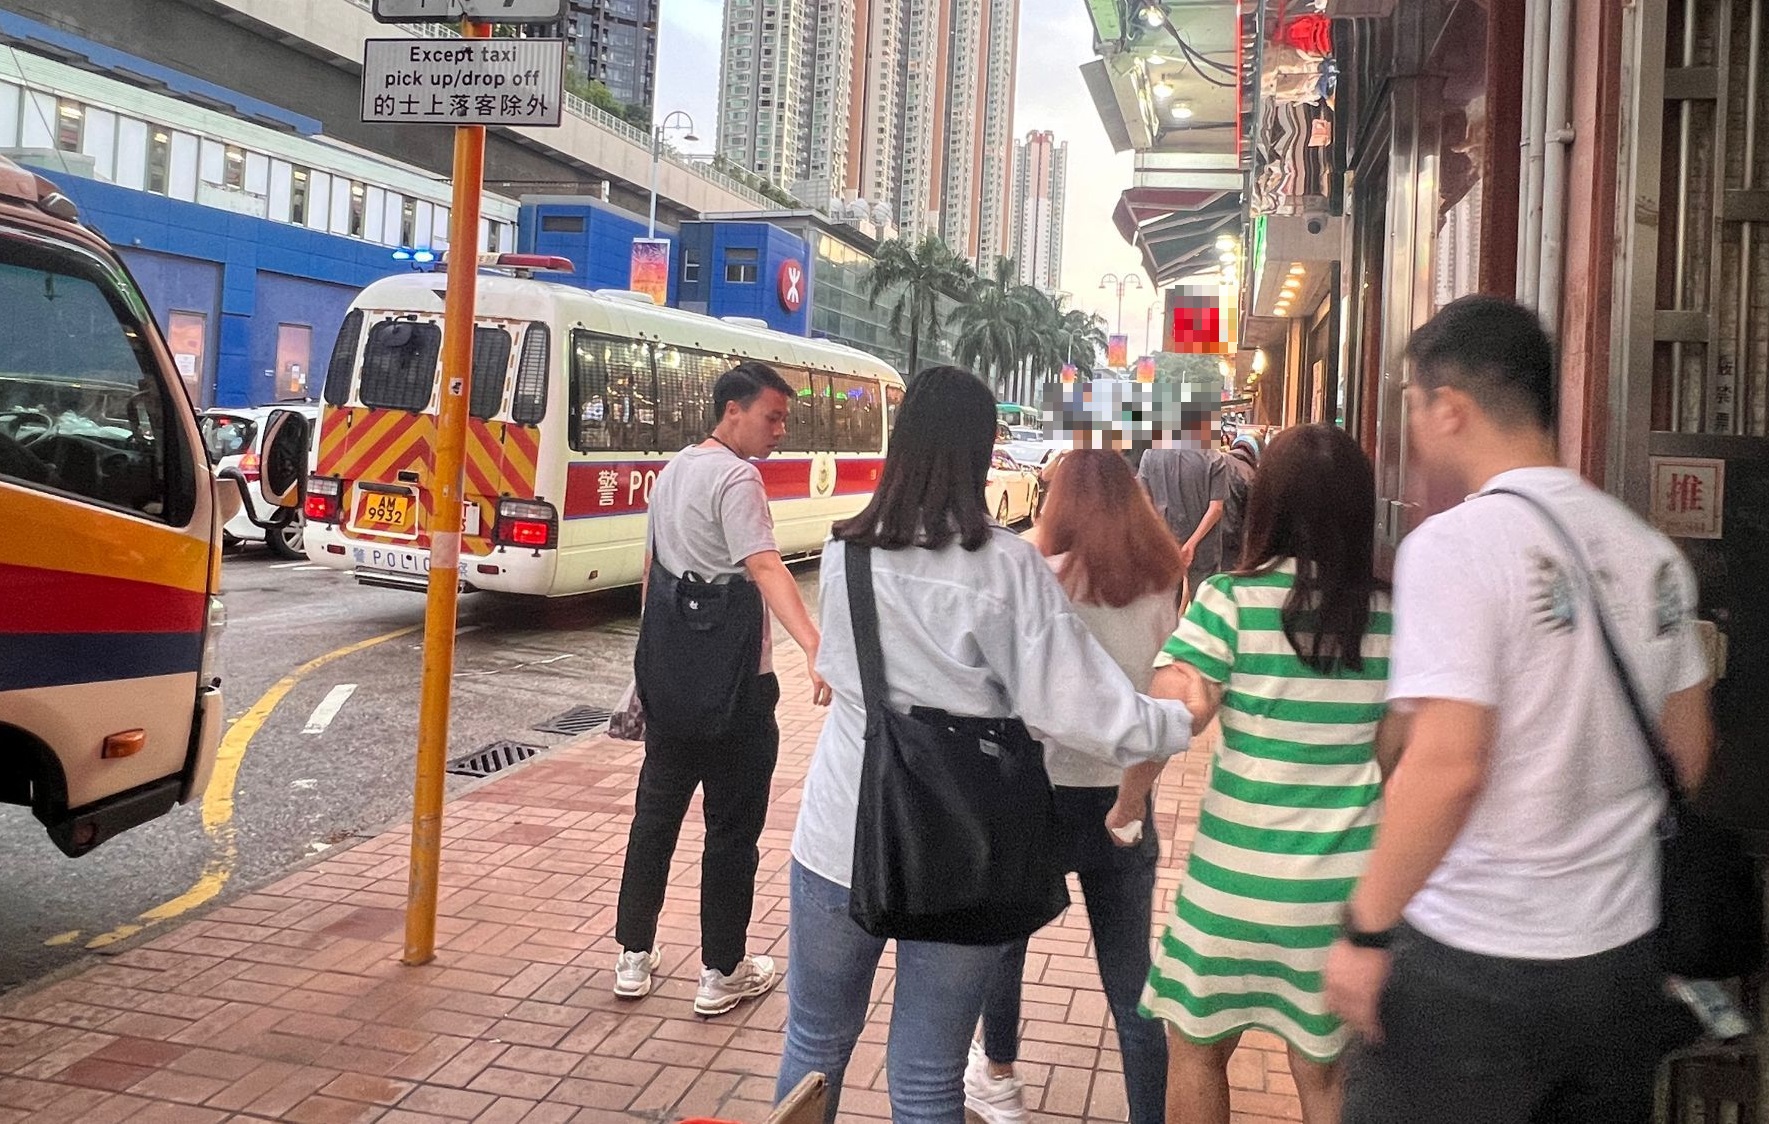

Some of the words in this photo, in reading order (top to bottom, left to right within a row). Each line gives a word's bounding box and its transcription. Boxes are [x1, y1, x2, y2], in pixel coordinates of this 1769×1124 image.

[410, 46, 474, 65] Except
[482, 46, 517, 62] taxi
[385, 70, 422, 87] pick
[431, 70, 505, 89] up/drop
[512, 70, 540, 86] off
[374, 93, 548, 117] 的士上落客除外
[597, 470, 619, 506] 警
[1667, 473, 1703, 513] 推
[378, 496, 397, 511] AM
[368, 507, 402, 524] 9932
